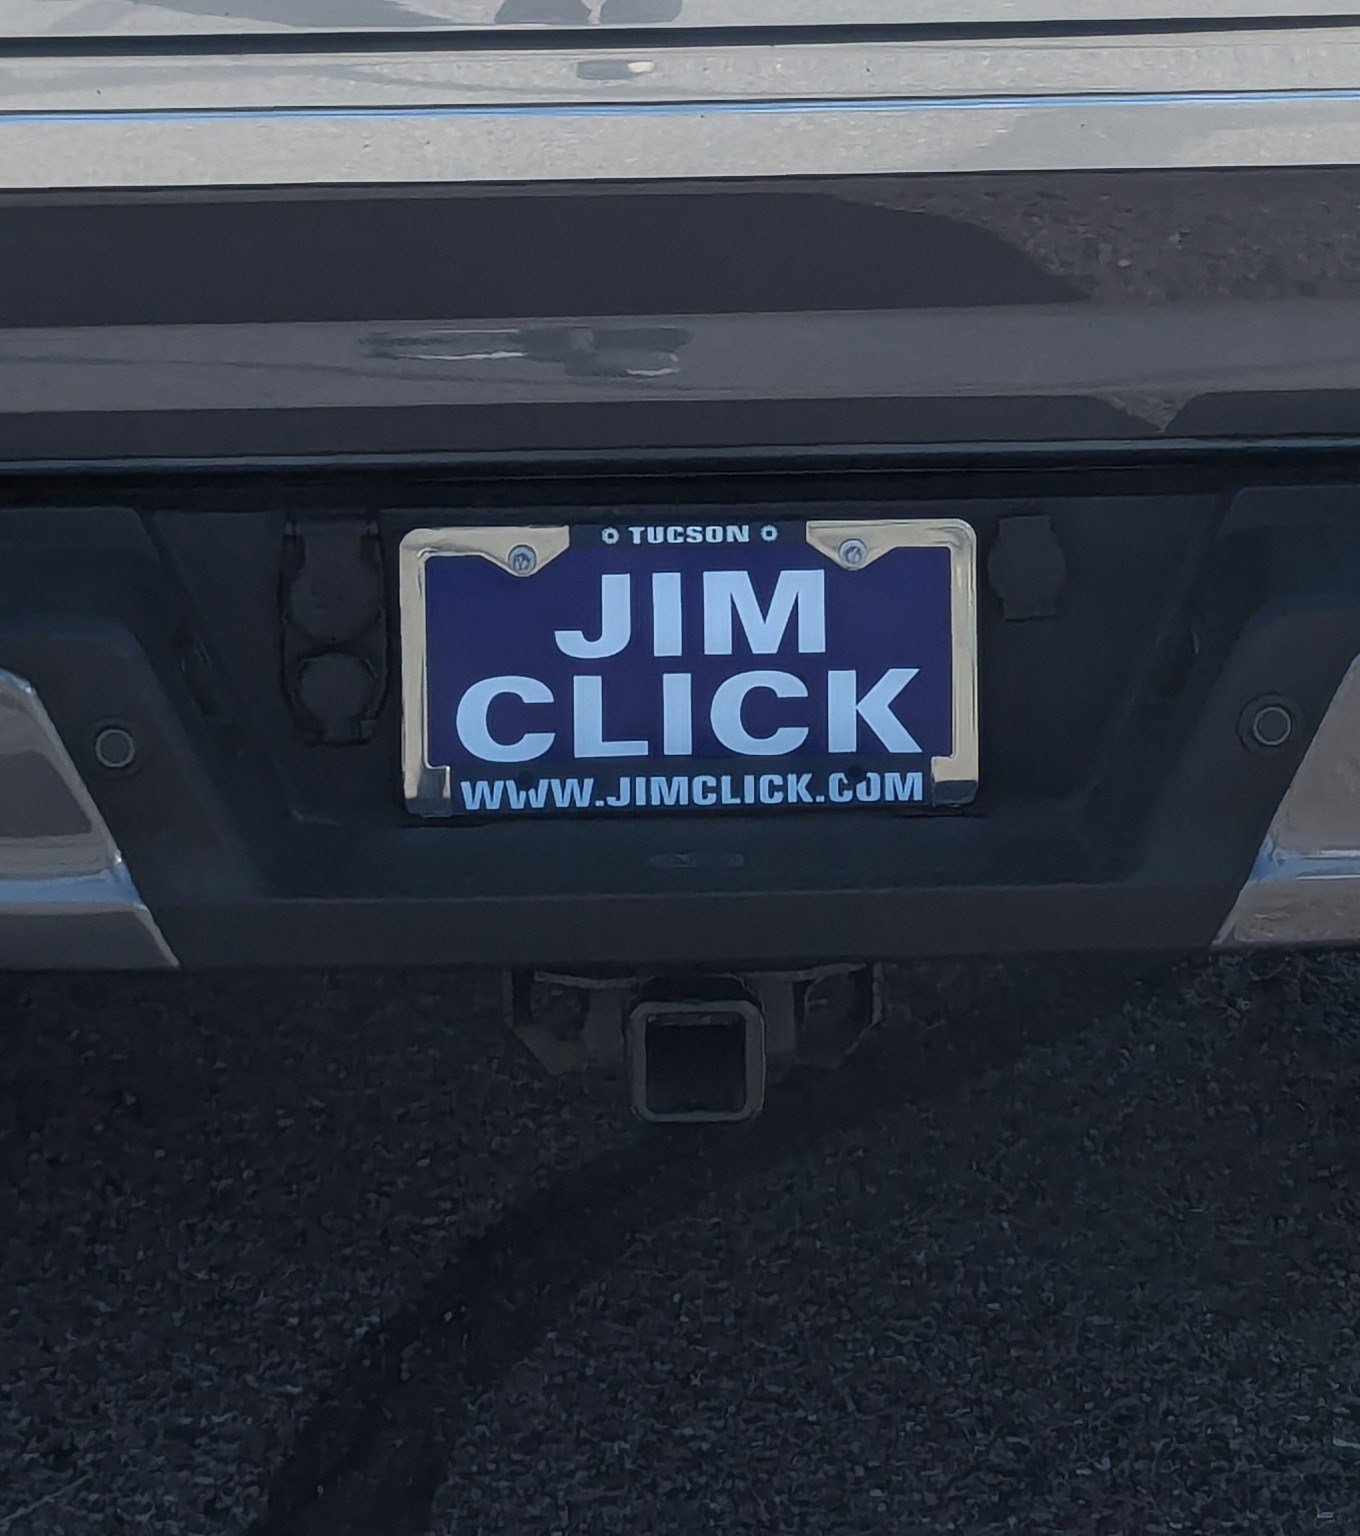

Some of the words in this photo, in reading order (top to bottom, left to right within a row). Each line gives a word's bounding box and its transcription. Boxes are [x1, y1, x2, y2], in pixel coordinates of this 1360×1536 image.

[628, 524, 750, 544] TUCSON
[554, 569, 826, 659] JIM
[455, 668, 923, 762] CLICK
[460, 772, 923, 810] WWW.JIMCLICK.COM
